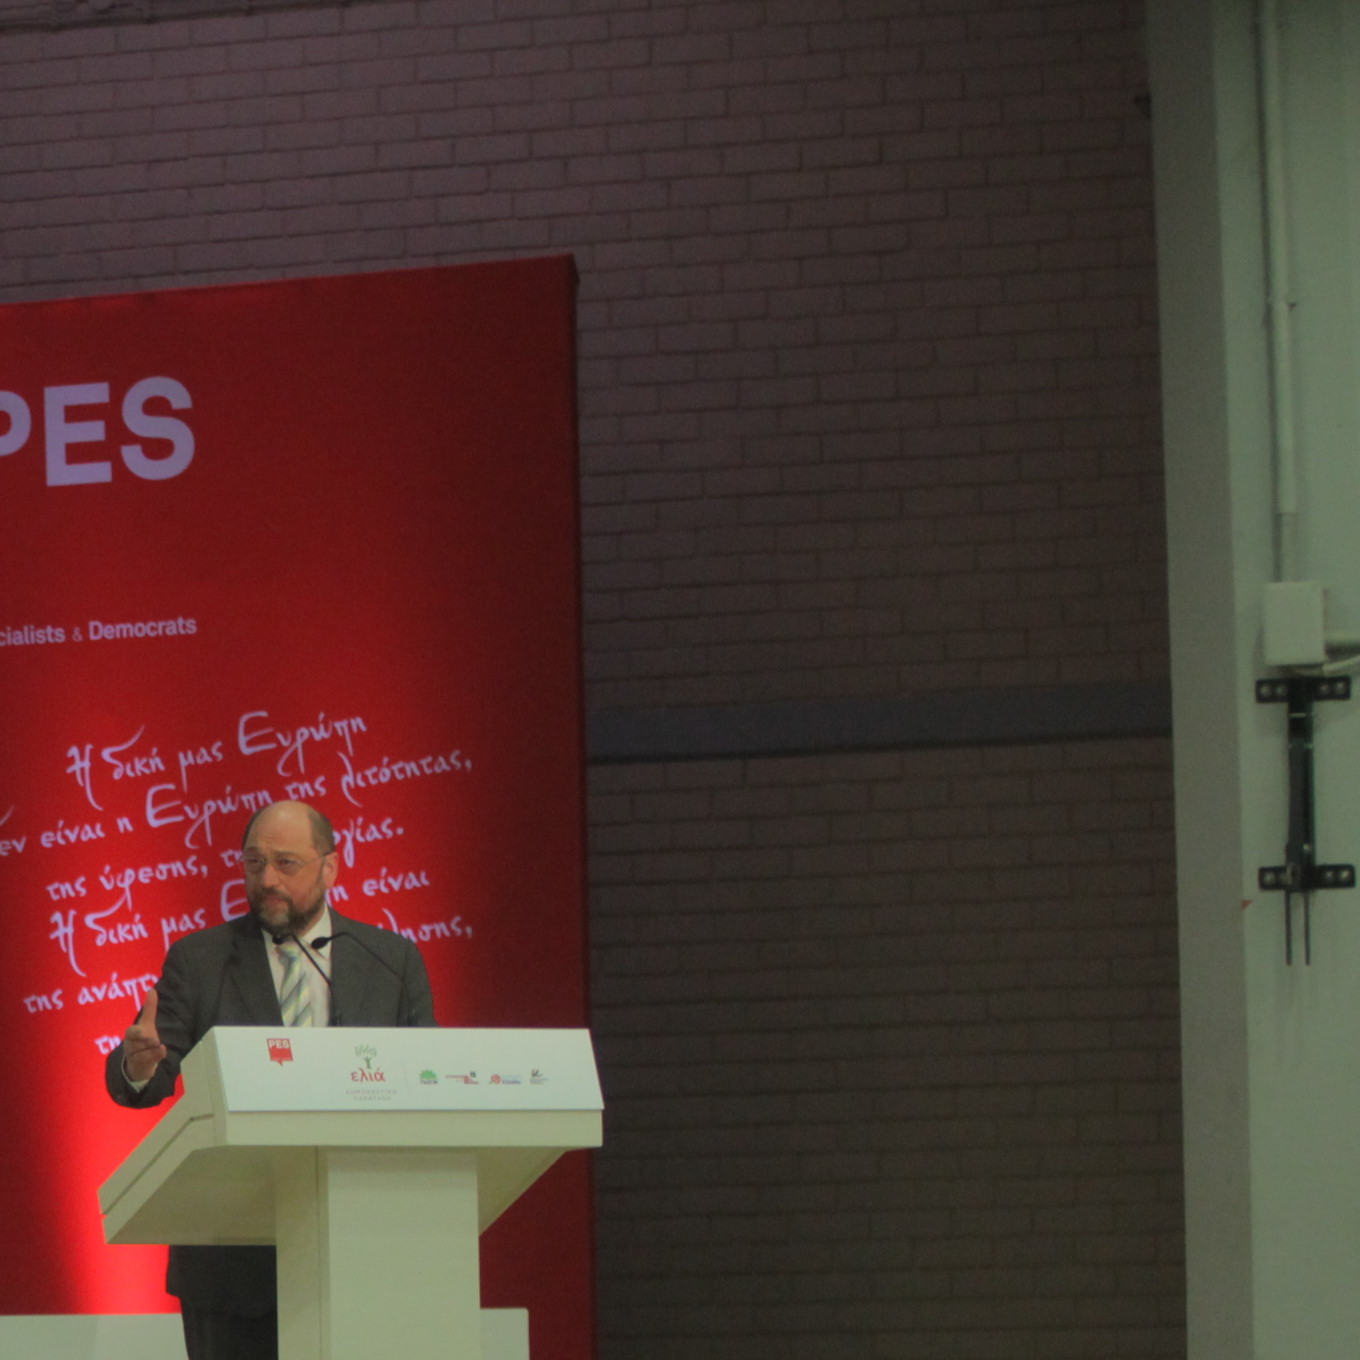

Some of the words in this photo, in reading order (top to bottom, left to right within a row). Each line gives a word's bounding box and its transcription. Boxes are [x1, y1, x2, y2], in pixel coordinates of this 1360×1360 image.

[71, 628, 83, 643] &
[87, 615, 199, 643] Democrats
[237, 710, 367, 777] Ευρώπη
[284, 775, 327, 801] της
[45, 877, 87, 901] της
[23, 989, 64, 1013] της
[268, 1039, 291, 1050] PES
[351, 1067, 386, 1083] ελιά
